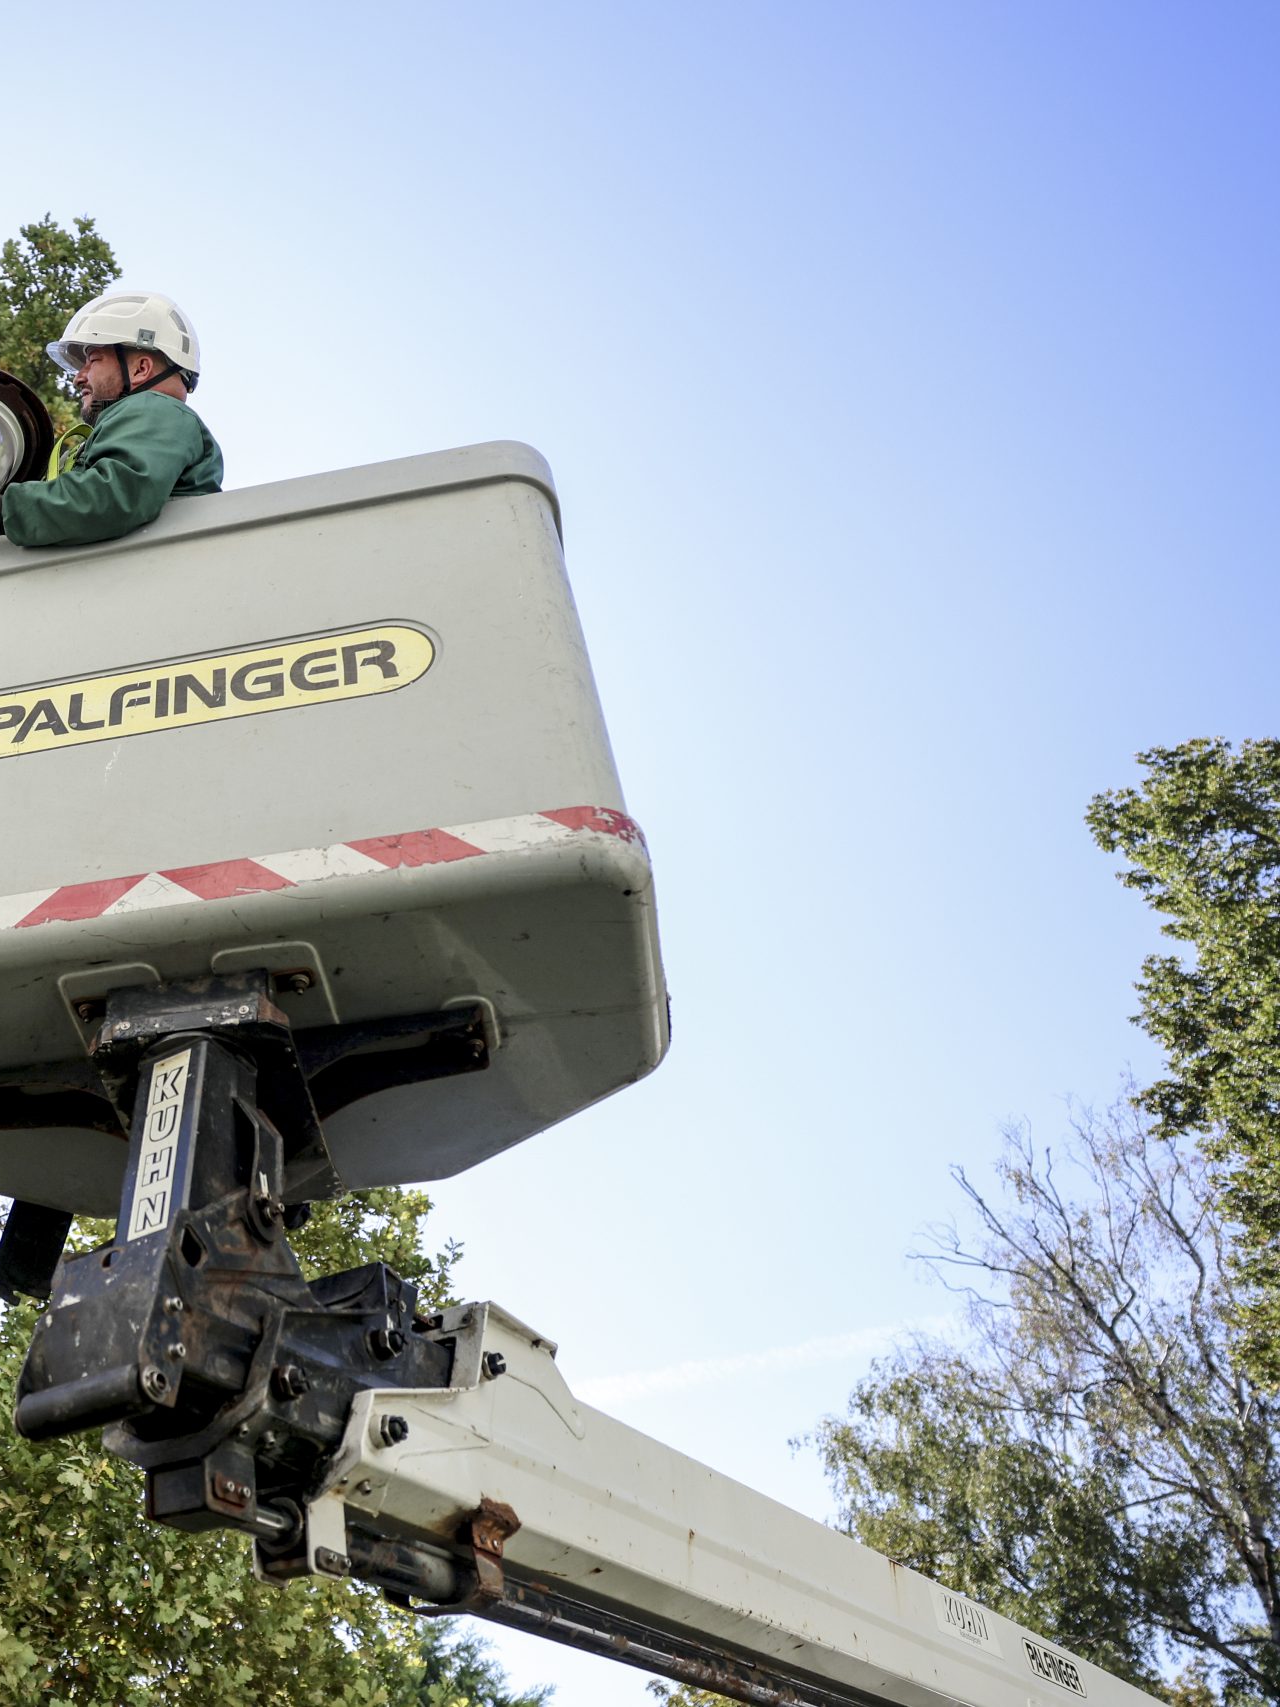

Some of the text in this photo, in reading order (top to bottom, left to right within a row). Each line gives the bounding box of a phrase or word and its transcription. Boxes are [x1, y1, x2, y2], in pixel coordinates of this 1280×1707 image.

[135, 1066, 184, 1232] KUHN
[942, 1593, 989, 1640] KUHN
[1025, 1642, 1084, 1693] PALFINGER
